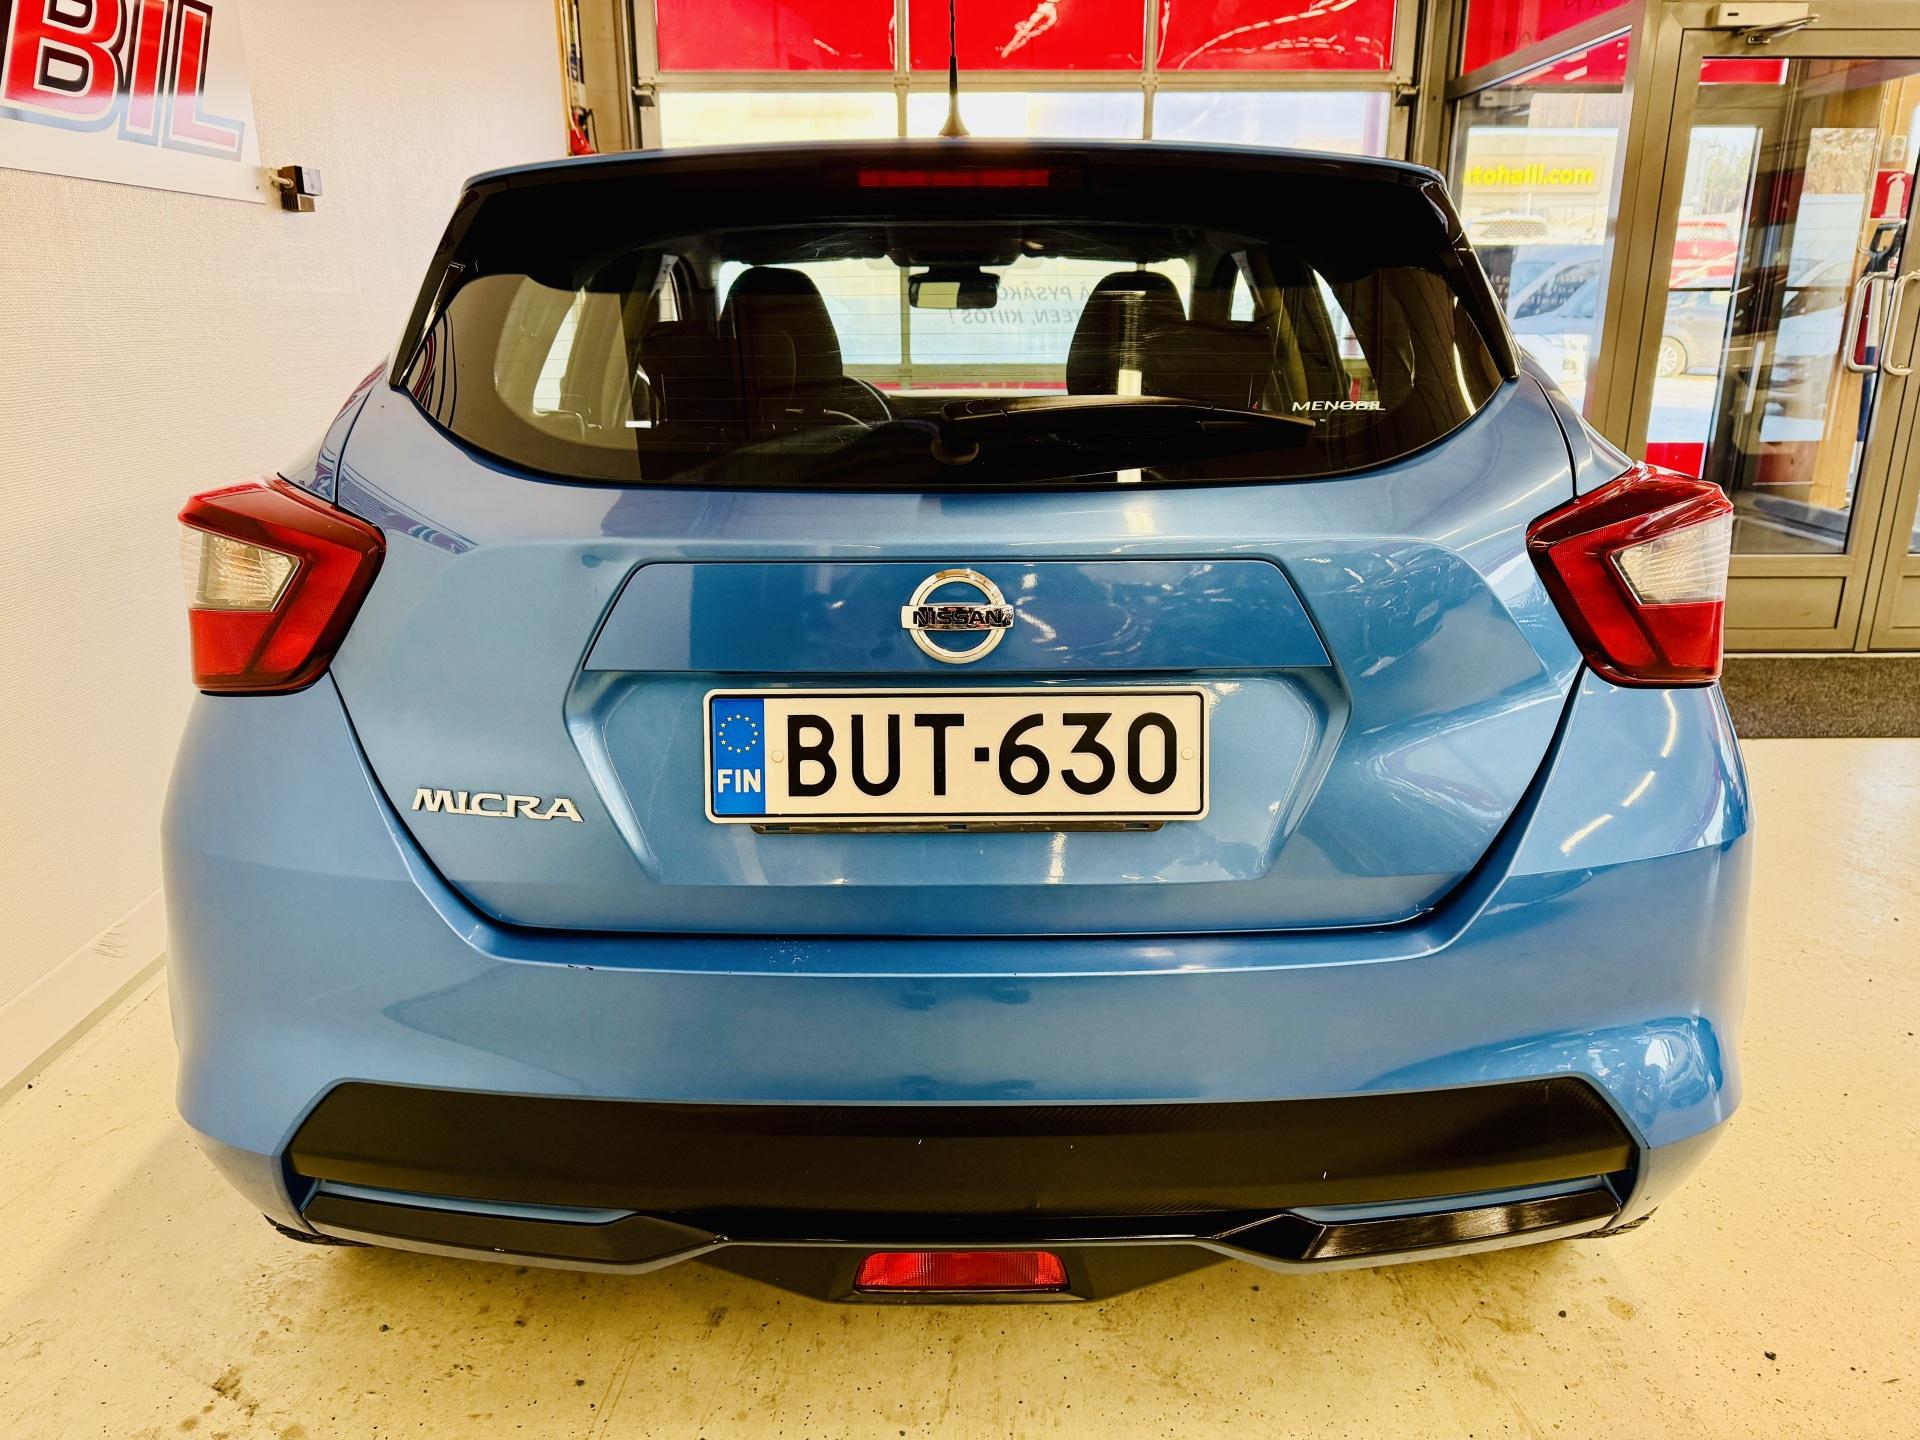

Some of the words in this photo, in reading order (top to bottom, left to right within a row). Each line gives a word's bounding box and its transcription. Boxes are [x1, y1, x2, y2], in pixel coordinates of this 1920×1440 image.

[1291, 400, 1387, 412] MENOBIL
[912, 608, 1003, 626] NISSAN
[717, 768, 762, 794] FIN
[411, 787, 585, 823] MICRA
